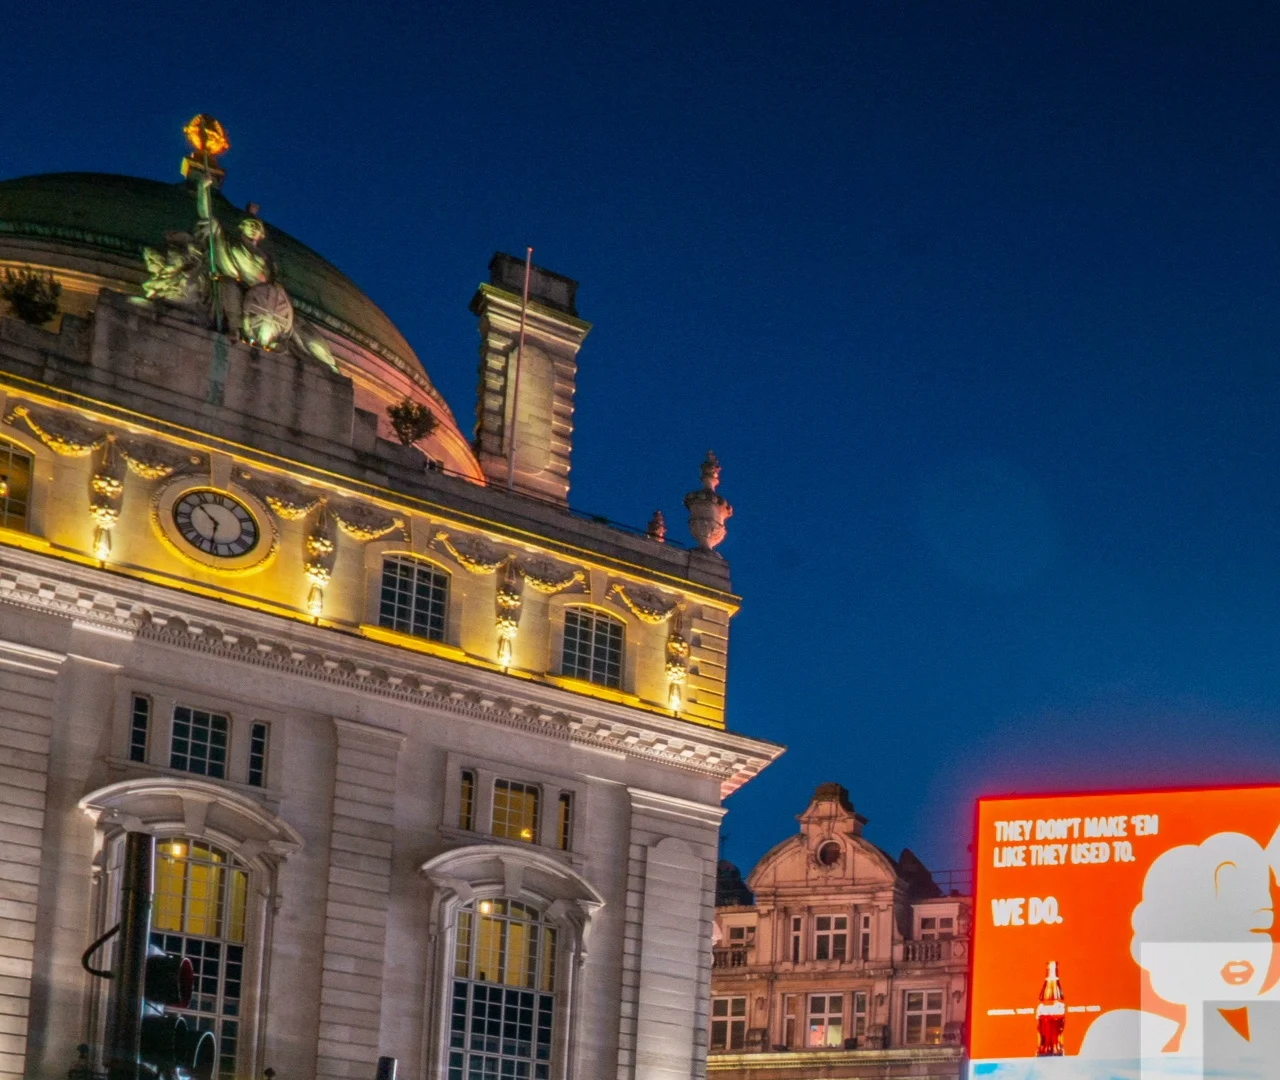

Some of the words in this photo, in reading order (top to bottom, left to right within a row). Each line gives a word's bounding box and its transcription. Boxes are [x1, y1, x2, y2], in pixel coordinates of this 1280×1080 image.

[994, 820, 1033, 842] THEY
[1035, 817, 1081, 841] DON'T
[1084, 815, 1128, 838] MAKE
[993, 846, 1027, 868] LIKE
[1029, 844, 1068, 866] THEY
[1071, 842, 1110, 864] USED
[1112, 841, 1136, 862] TO.
[991, 898, 1025, 926] WE
[1028, 896, 1063, 925] DO.
